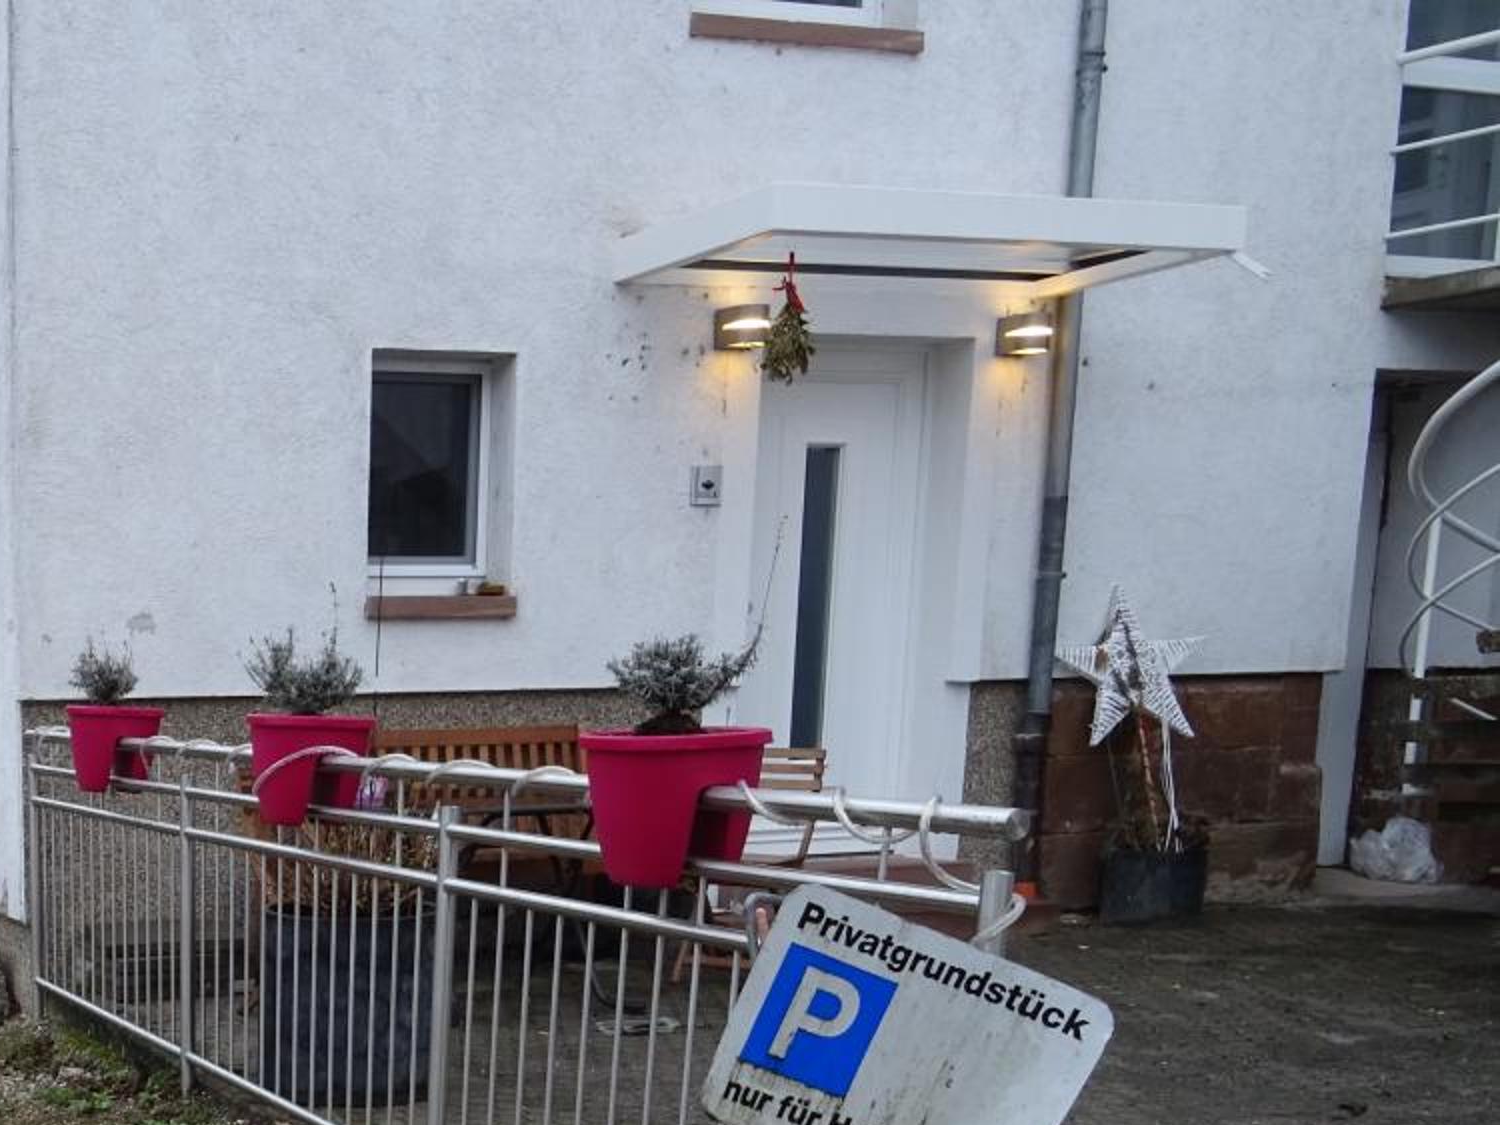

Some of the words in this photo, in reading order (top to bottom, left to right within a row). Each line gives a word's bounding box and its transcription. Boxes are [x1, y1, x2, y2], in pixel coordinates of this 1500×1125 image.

[767, 965, 861, 1059] P
[797, 901, 1091, 1041] Privatgrundstück
[723, 1079, 773, 1113] nur
